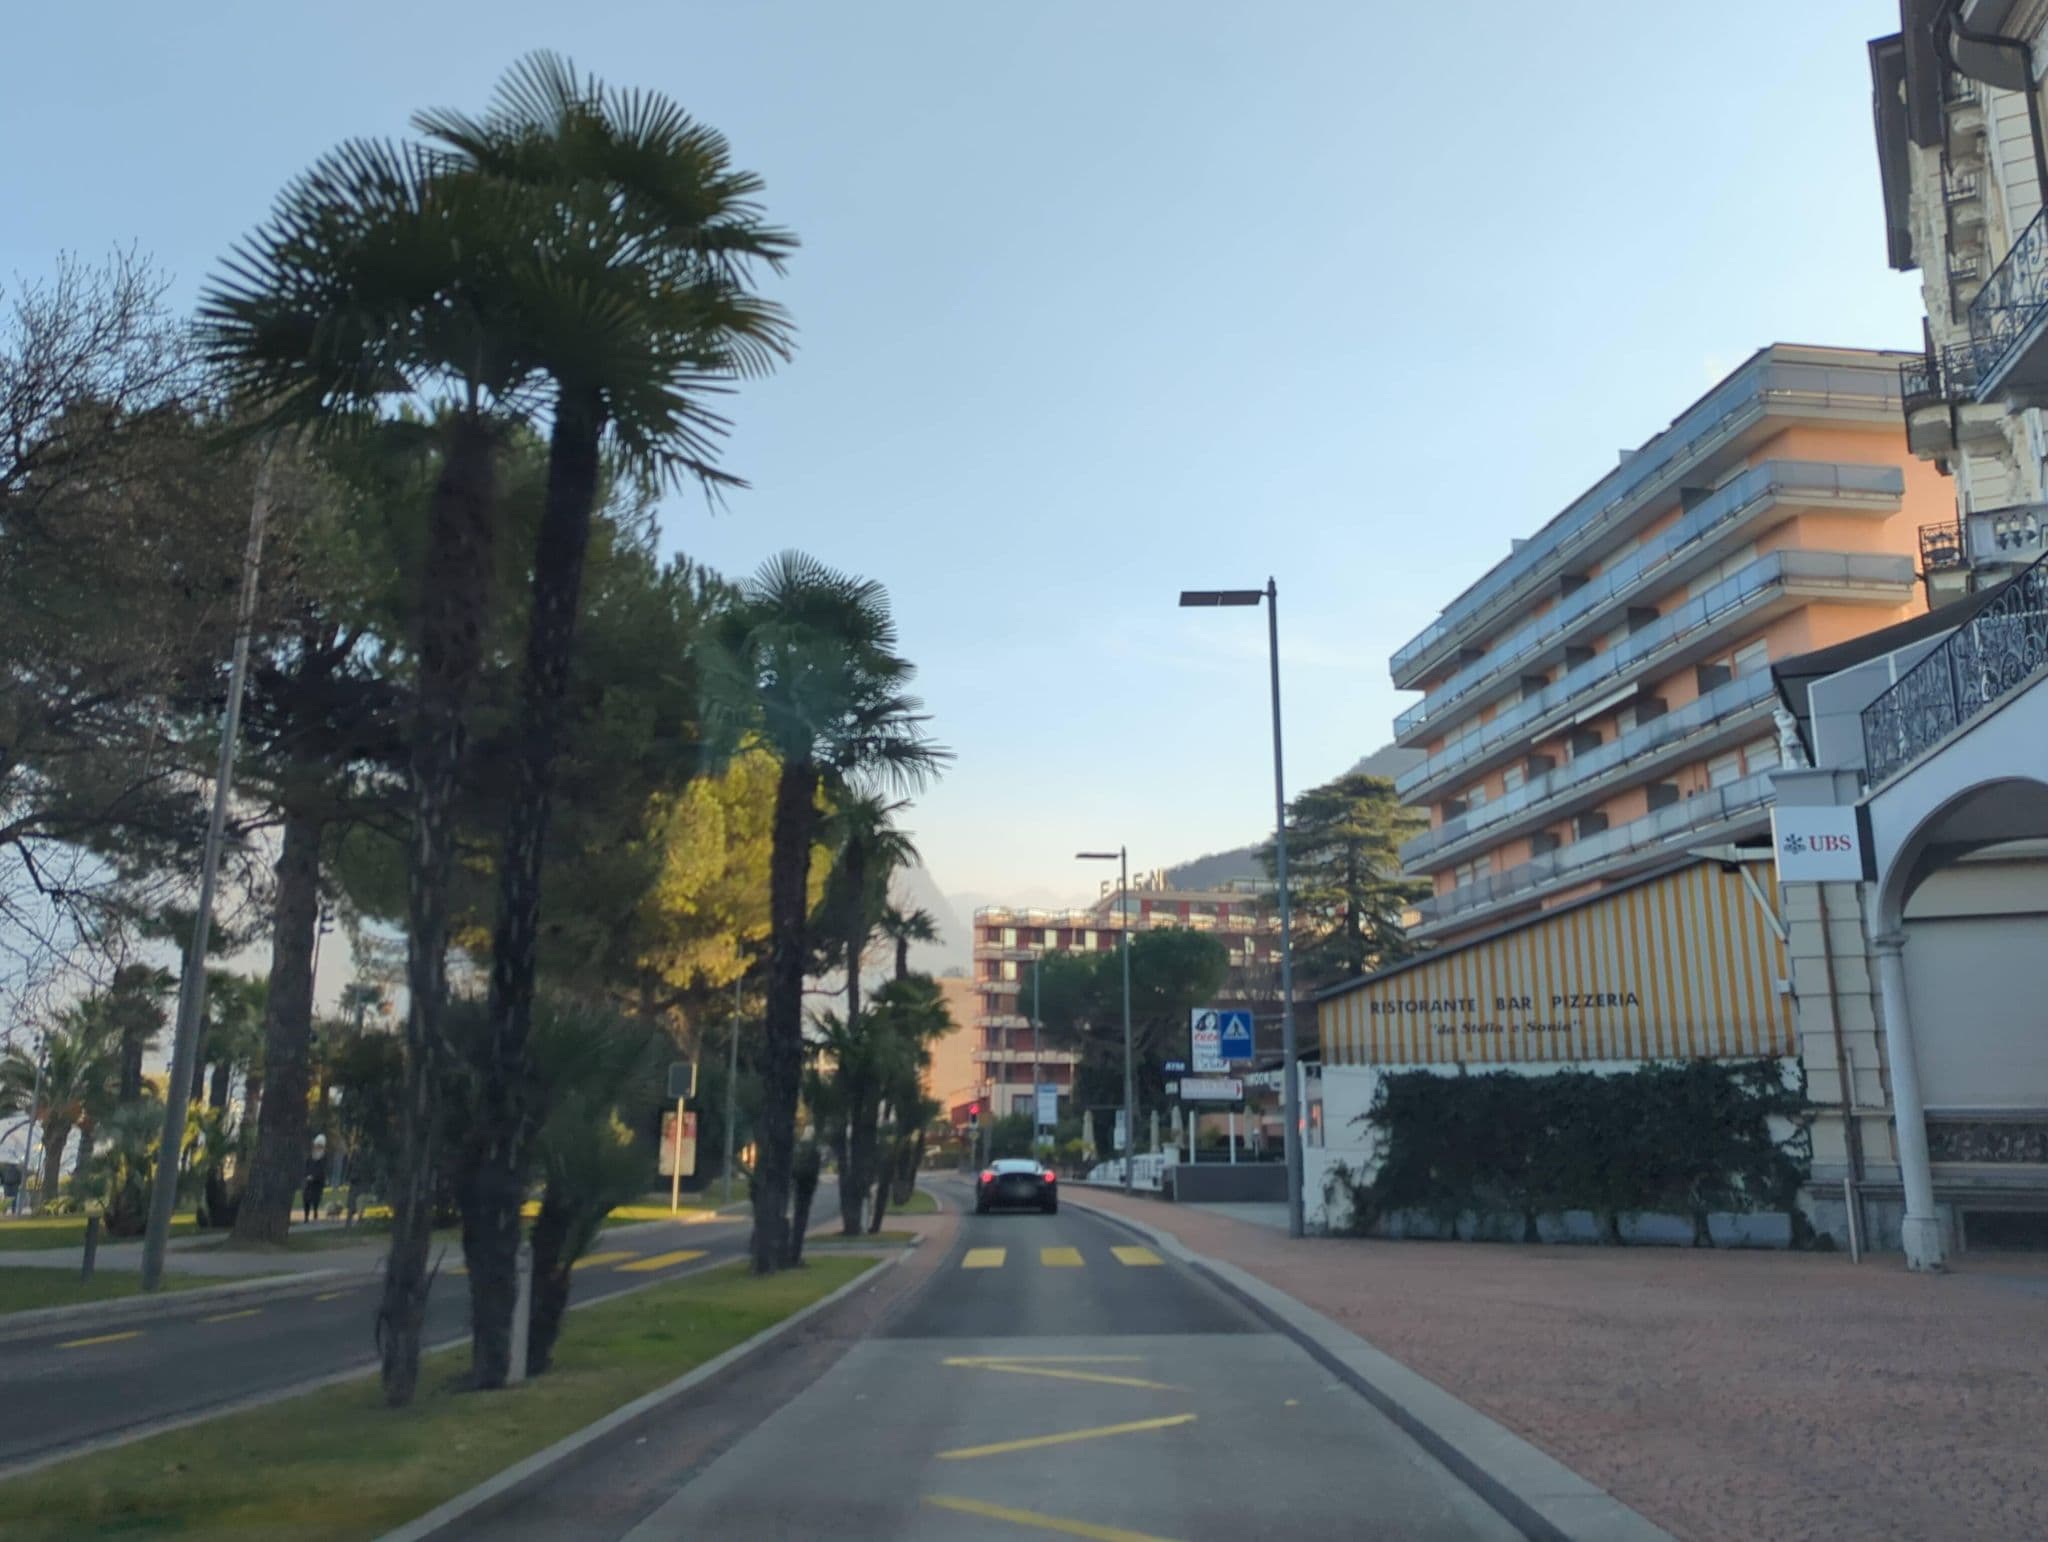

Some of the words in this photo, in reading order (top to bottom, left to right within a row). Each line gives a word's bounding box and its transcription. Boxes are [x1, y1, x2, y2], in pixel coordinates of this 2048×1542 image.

[1808, 834, 1852, 852] UBS
[1370, 998, 1475, 1014] RISTORANTE
[1496, 996, 1531, 1010] BAR
[1552, 991, 1639, 1008] PIZZERIA
